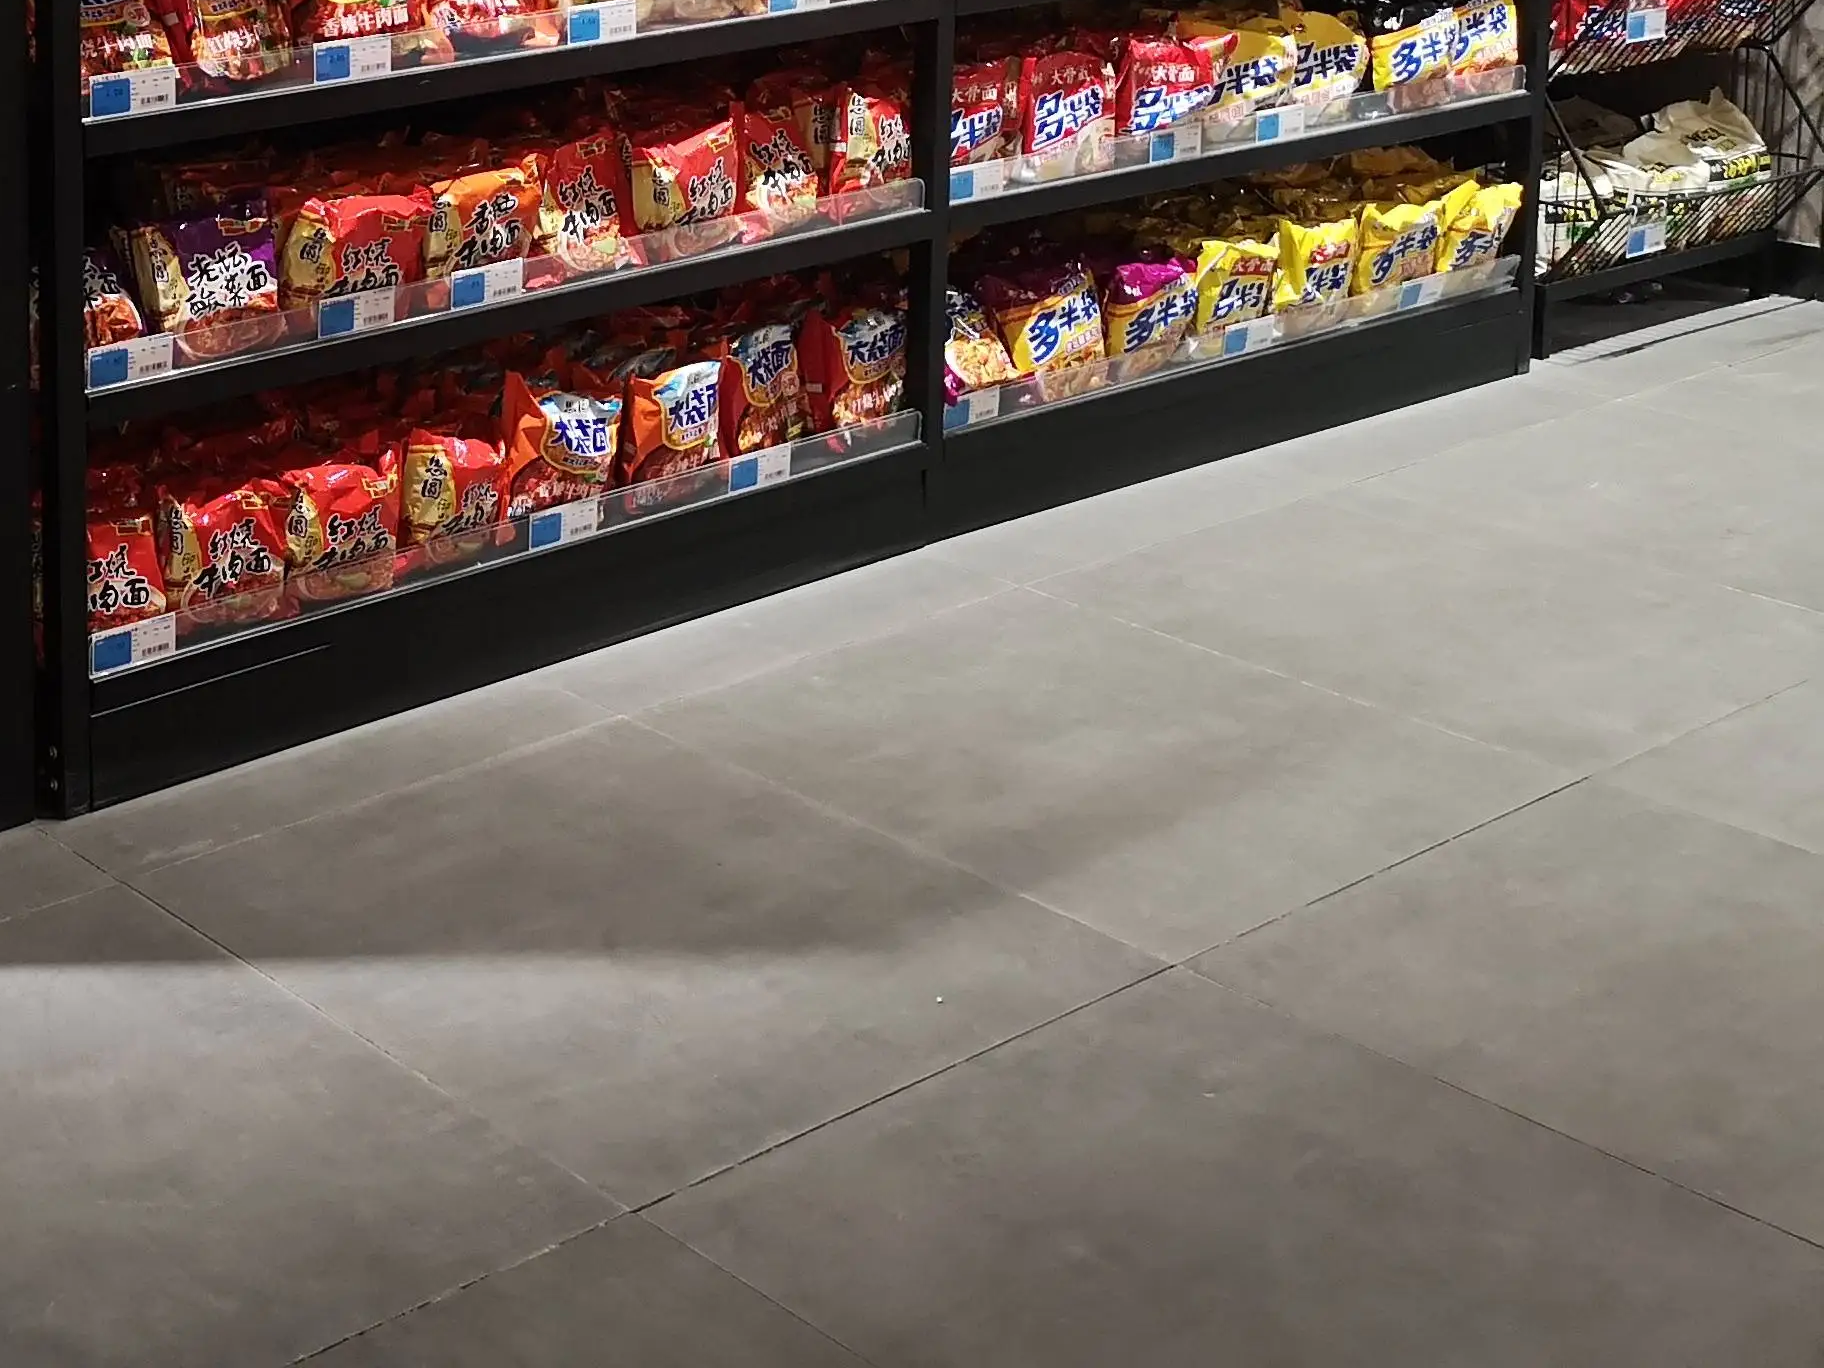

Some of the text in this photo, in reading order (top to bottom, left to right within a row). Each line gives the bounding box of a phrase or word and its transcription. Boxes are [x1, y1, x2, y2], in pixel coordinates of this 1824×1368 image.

[1033, 87, 1103, 149] 多半袋
[1028, 285, 1099, 365] 多半袋
[422, 455, 448, 499] 思圆
[209, 518, 259, 559] 红烧
[328, 504, 388, 543] 红烧
[193, 548, 272, 599] 牛肉面
